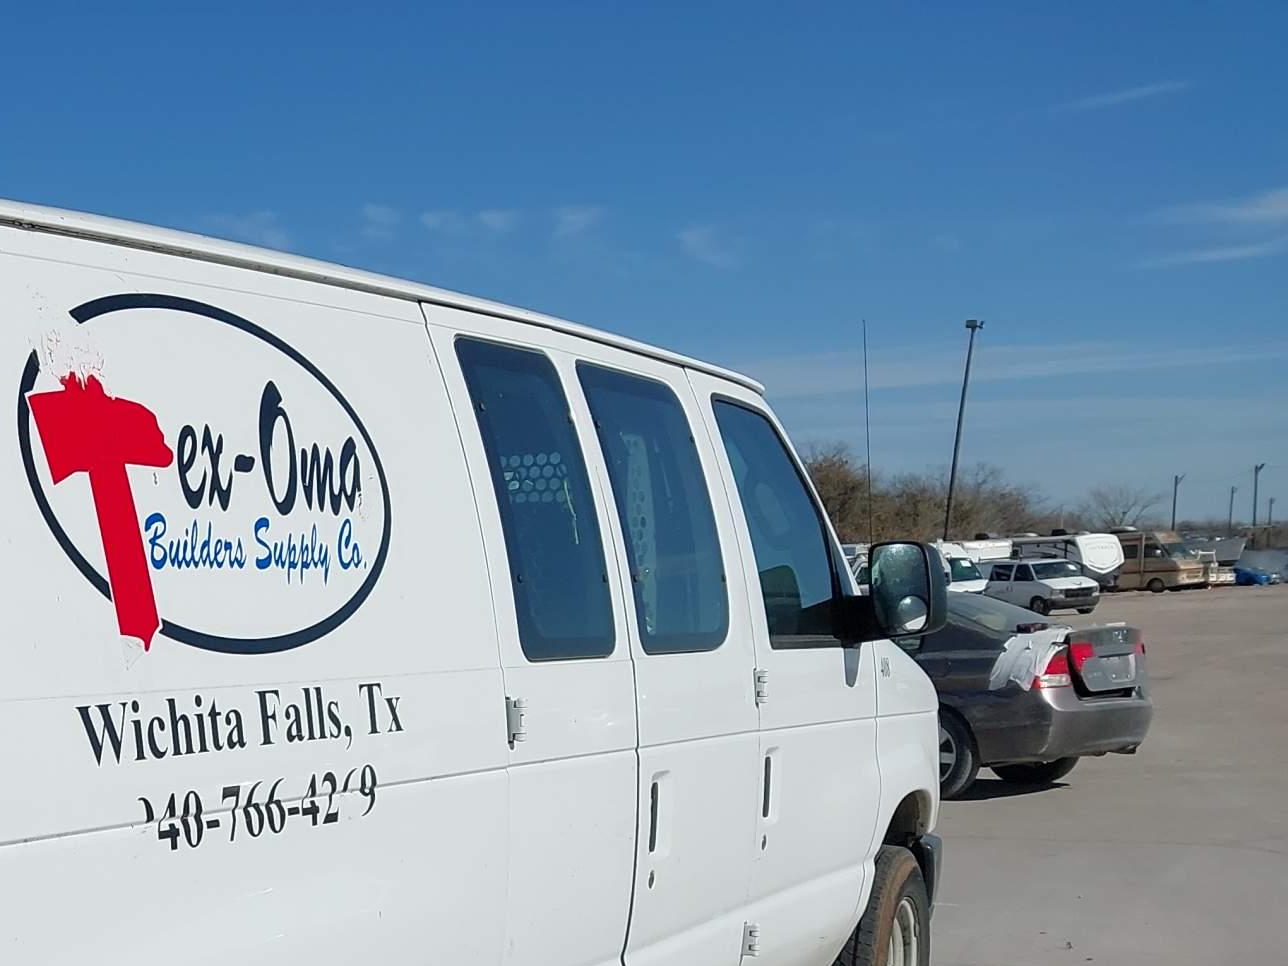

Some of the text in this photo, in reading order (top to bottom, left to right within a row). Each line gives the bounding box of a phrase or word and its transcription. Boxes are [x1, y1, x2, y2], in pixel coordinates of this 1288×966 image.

[144, 512, 368, 586] Builders Supply Co.
[76, 682, 405, 767] Wichita Falls, Tx
